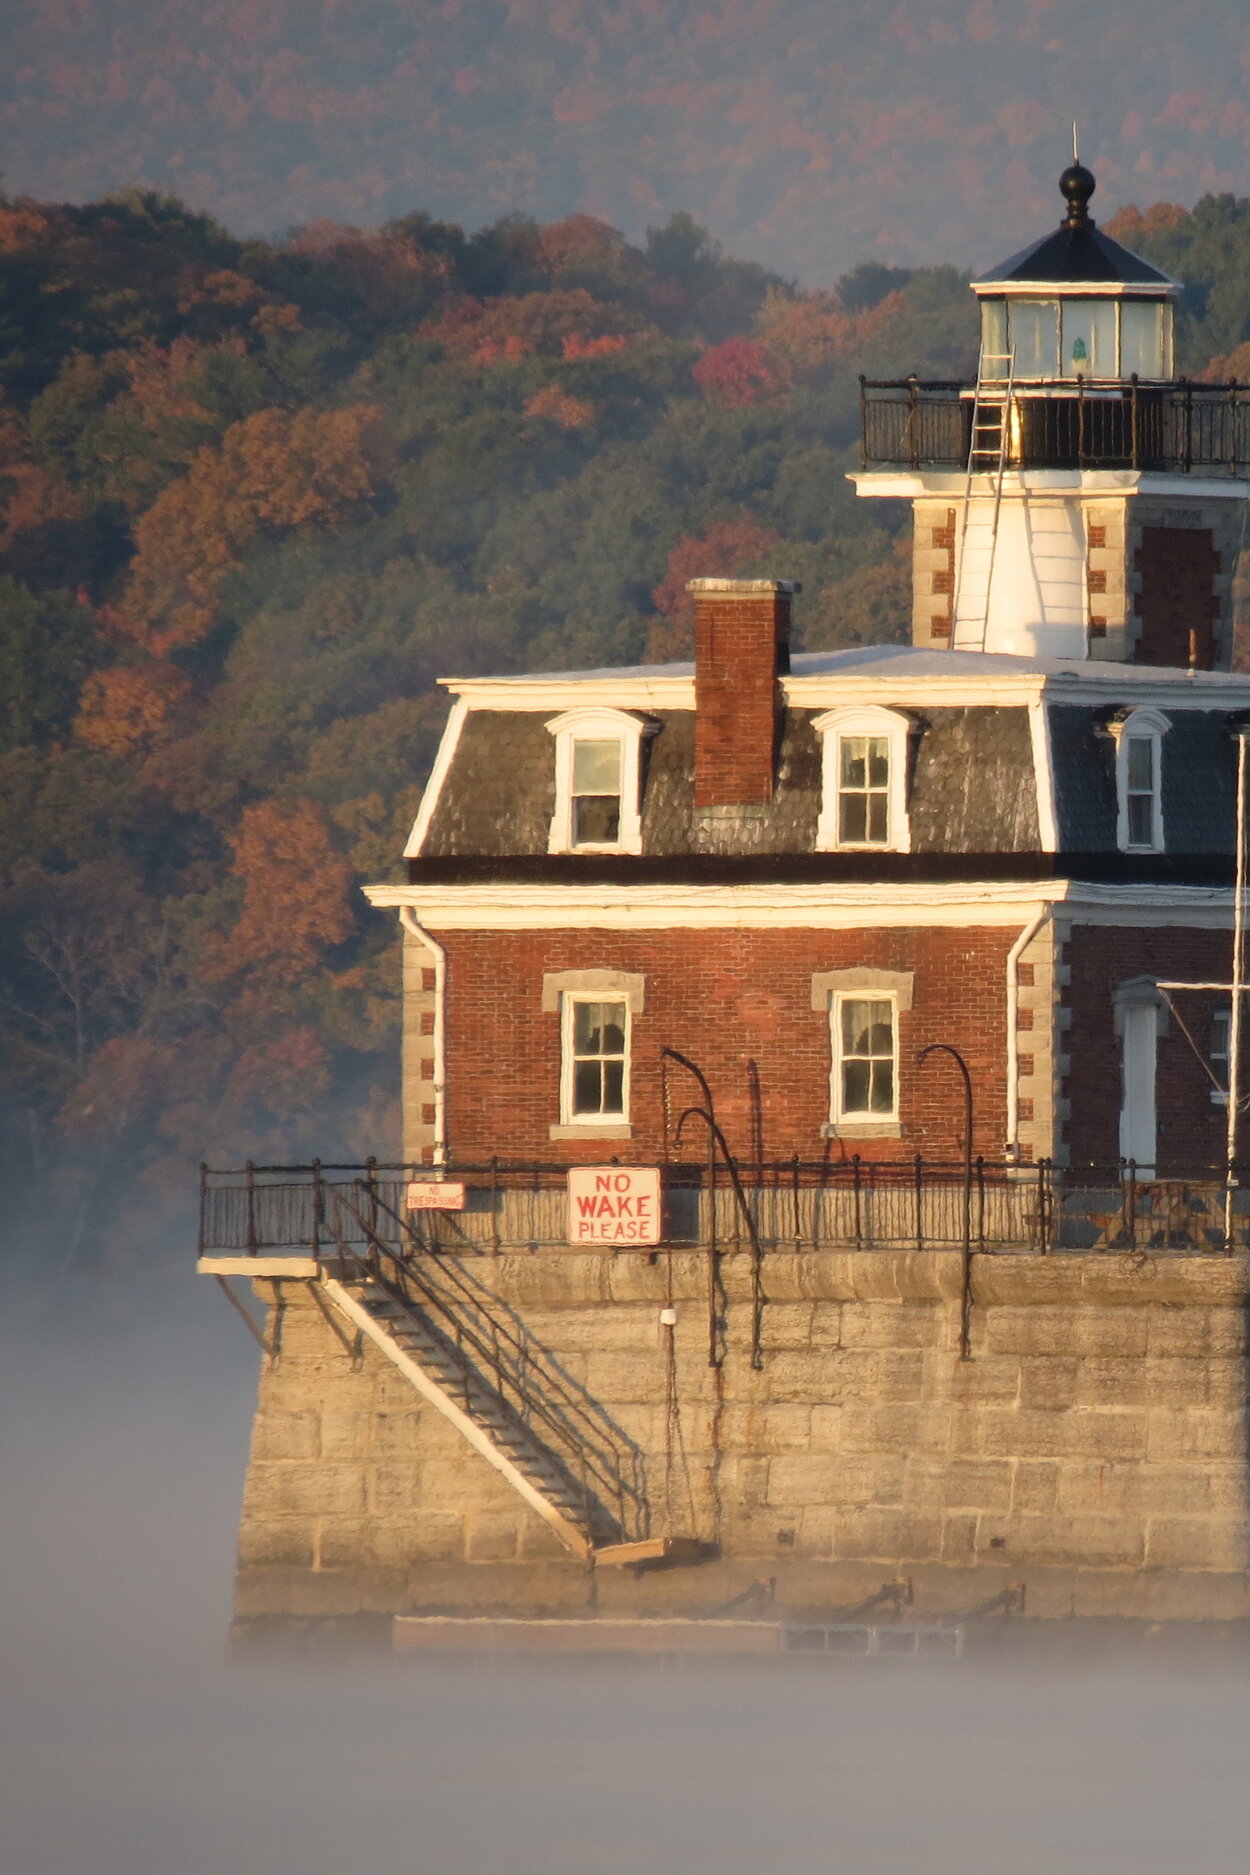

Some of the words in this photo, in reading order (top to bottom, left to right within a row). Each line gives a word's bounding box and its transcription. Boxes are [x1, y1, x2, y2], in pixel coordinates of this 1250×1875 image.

[429, 1185, 440, 1196] NO
[595, 1173, 631, 1193] NO
[576, 1195, 651, 1218] WAKE
[578, 1220, 651, 1240] PLEASE
